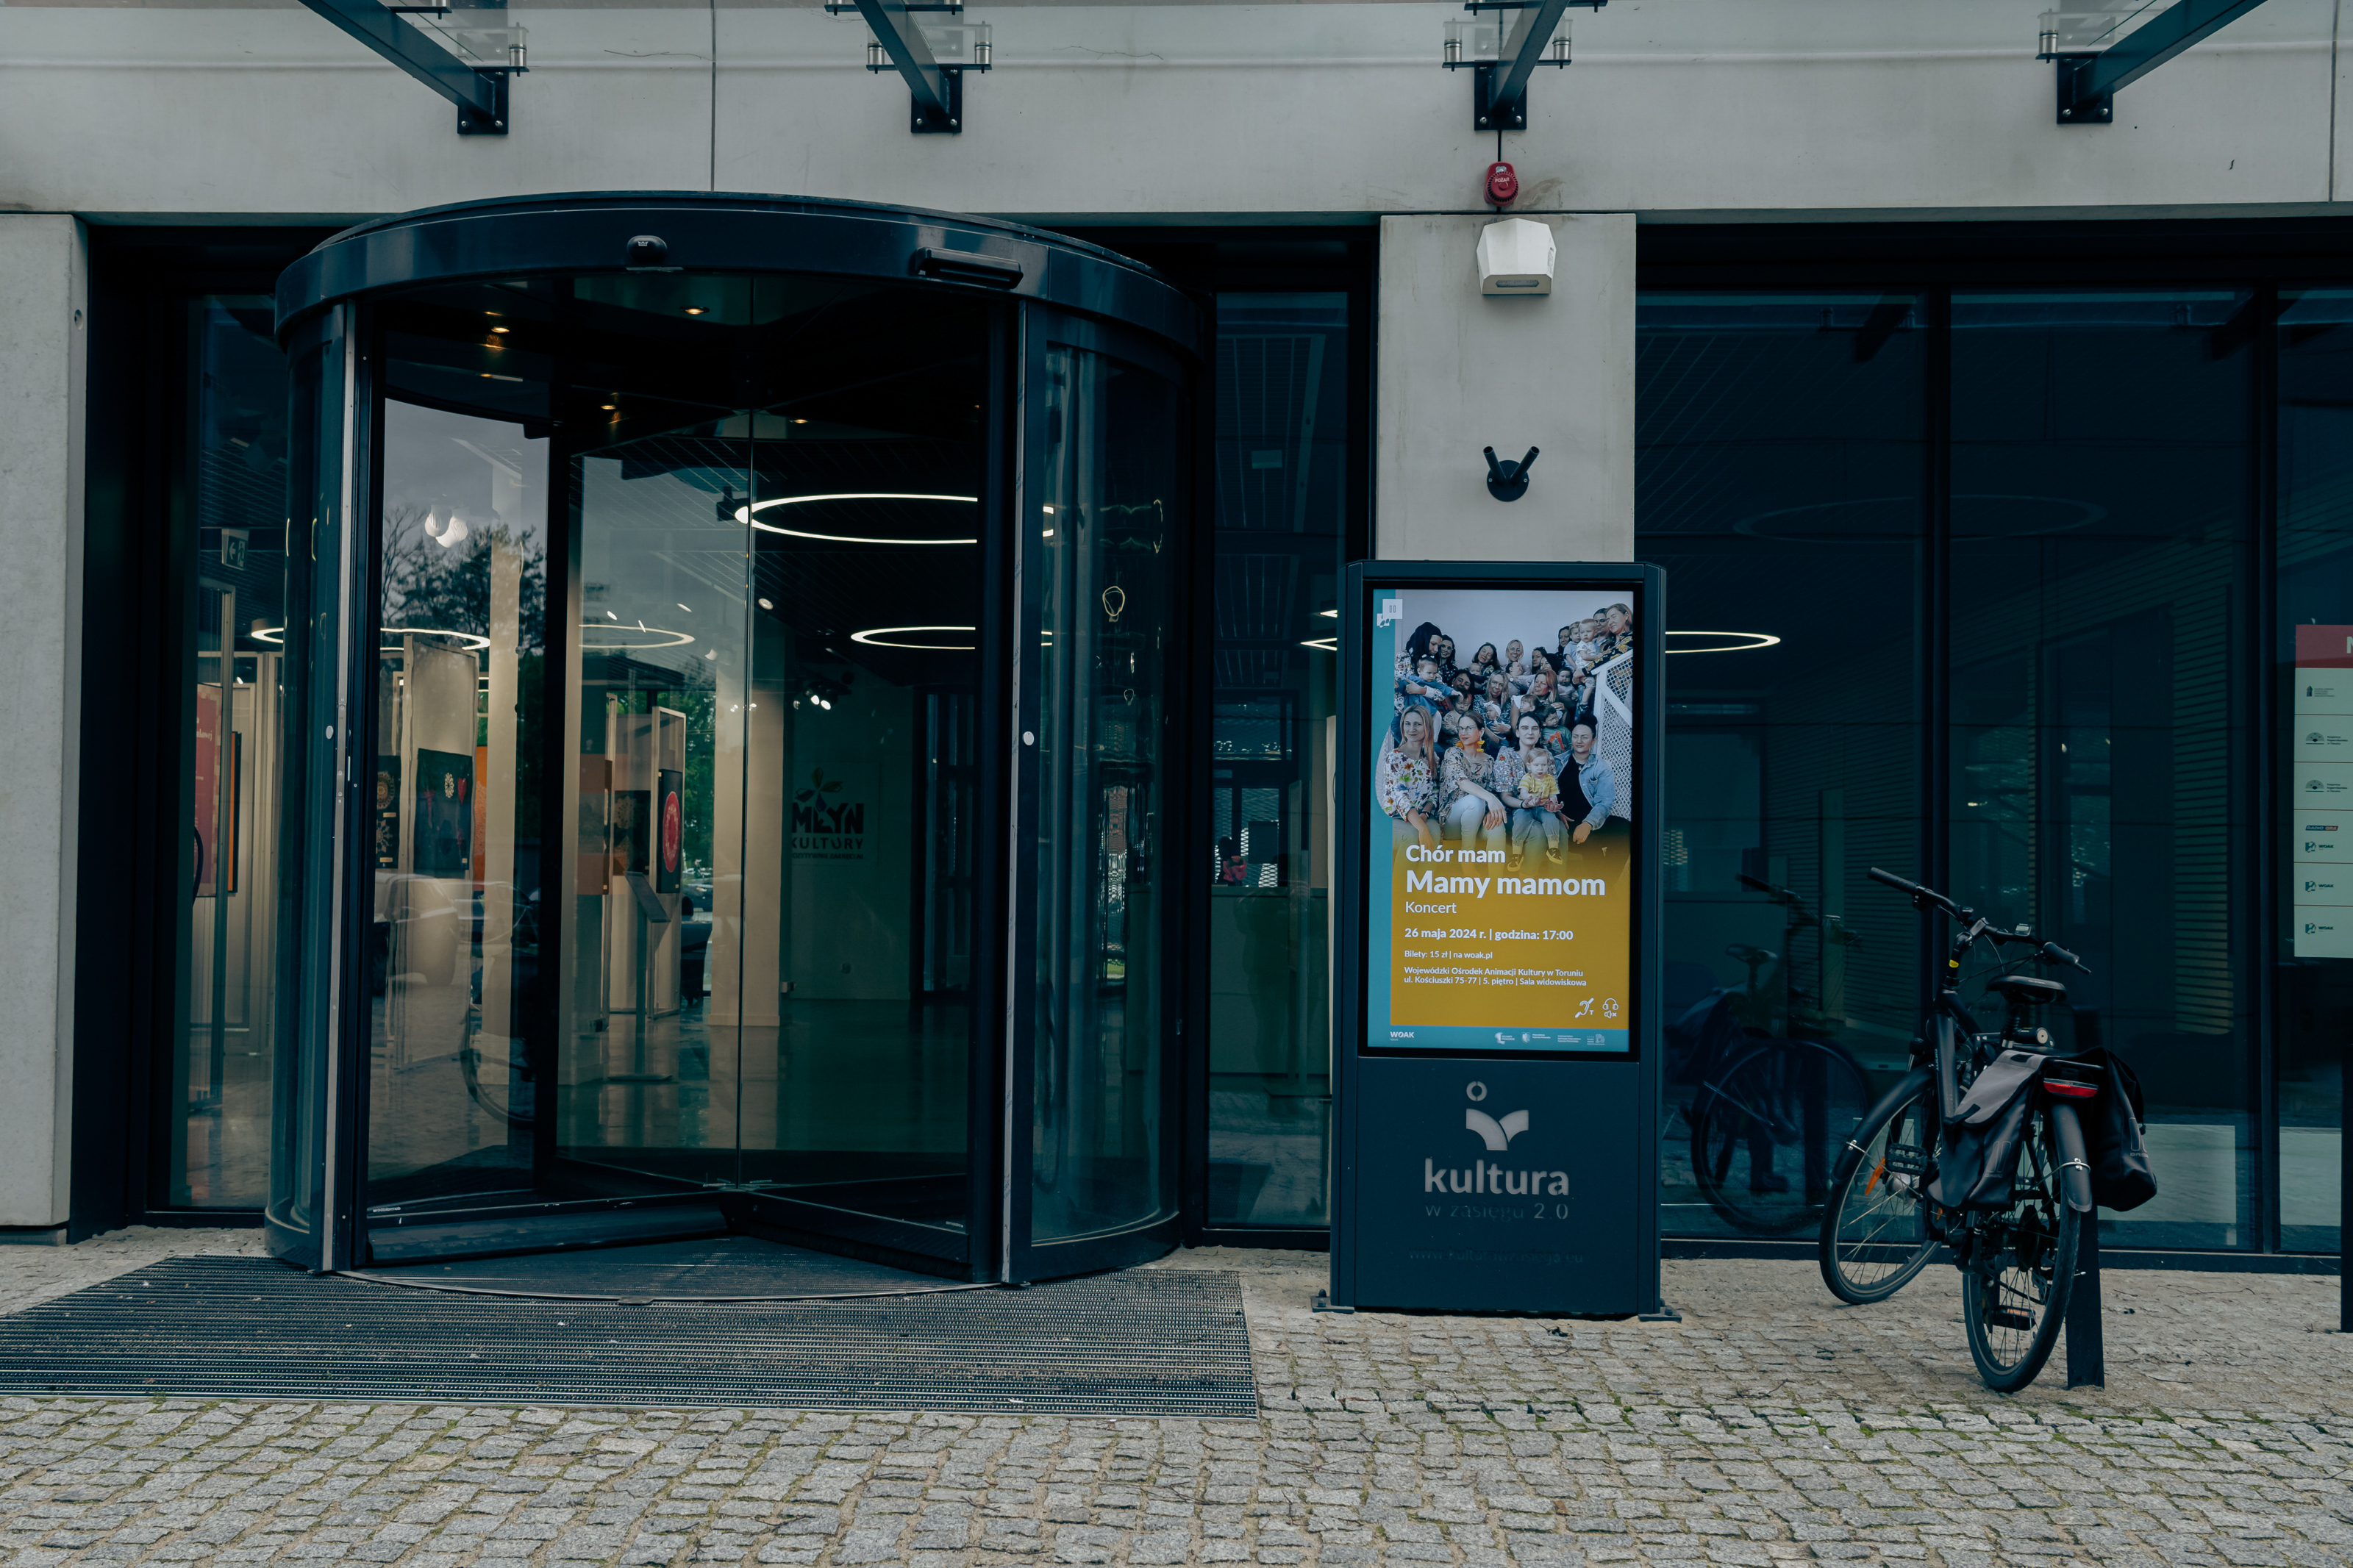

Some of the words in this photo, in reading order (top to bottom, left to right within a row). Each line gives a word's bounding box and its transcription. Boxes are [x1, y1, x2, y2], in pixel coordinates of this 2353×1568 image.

[1406, 845, 1454, 862] Chór
[1458, 850, 1505, 863] mam
[1407, 870, 1490, 898] Mamy
[1497, 878, 1605, 895] mamom
[1406, 901, 1457, 913] Koncert
[1404, 928, 1418, 937] 26
[1421, 928, 1446, 940] maja
[1449, 928, 1477, 938] 2024
[1495, 929, 1540, 941] godzina:
[1543, 930, 1574, 939] 17:00
[1404, 951, 1427, 959] Bilety:
[1464, 951, 1493, 959] woak.pl
[1404, 967, 1449, 975] Wojewódzki
[1485, 968, 1516, 976] Animacji
[1425, 1158, 1568, 1195] kultura
[1426, 1206, 1440, 1217] w
[1451, 1203, 1524, 1222] zasięgu
[1534, 1203, 1568, 1220] 2.0
